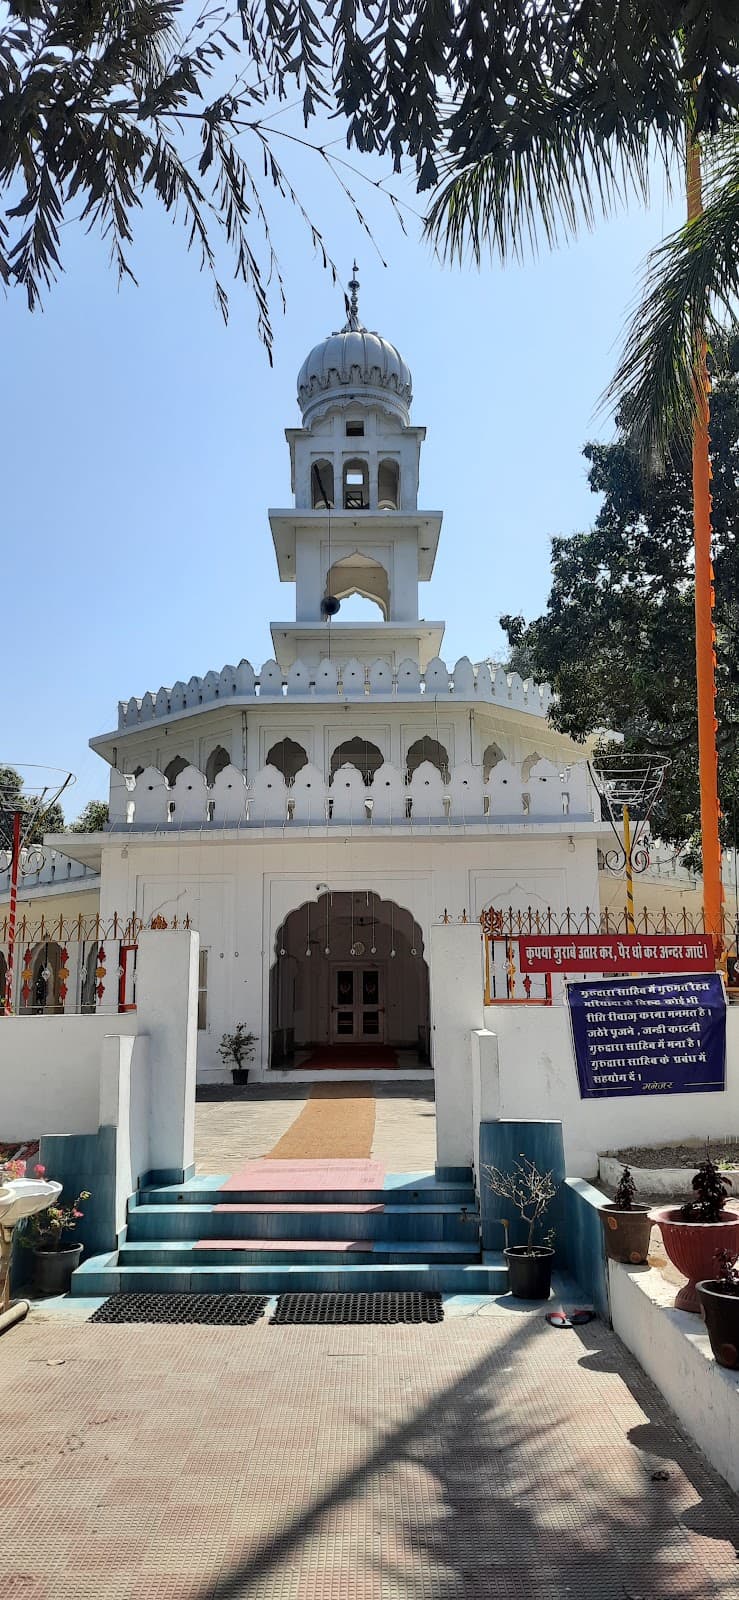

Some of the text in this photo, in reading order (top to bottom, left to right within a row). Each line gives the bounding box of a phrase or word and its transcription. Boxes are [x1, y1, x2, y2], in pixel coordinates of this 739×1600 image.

[525, 946, 552, 965] कृपया
[577, 946, 598, 959] उतार
[598, 946, 617, 961] कर,
[617, 942, 631, 959] पैर
[631, 942, 642, 959] धो
[643, 946, 658, 959] कर
[659, 945, 684, 959] अन्दर
[616, 986, 647, 996] साहिब
[686, 996, 699, 1004] भी
[586, 1012, 606, 1022] रीति
[639, 1011, 666, 1019] करना
[667, 1009, 698, 1018] मनमत
[667, 1022, 701, 1033] काटनी
[625, 1040, 656, 1051] साहिब
[658, 1038, 666, 1049] में
[667, 1040, 687, 1049] मना
[627, 1055, 658, 1066] साहिब
[659, 1054, 671, 1065] के
[673, 1052, 697, 1064] प्रबंध
[698, 1051, 707, 1062] में
[592, 1072, 627, 1083] सहयोग
